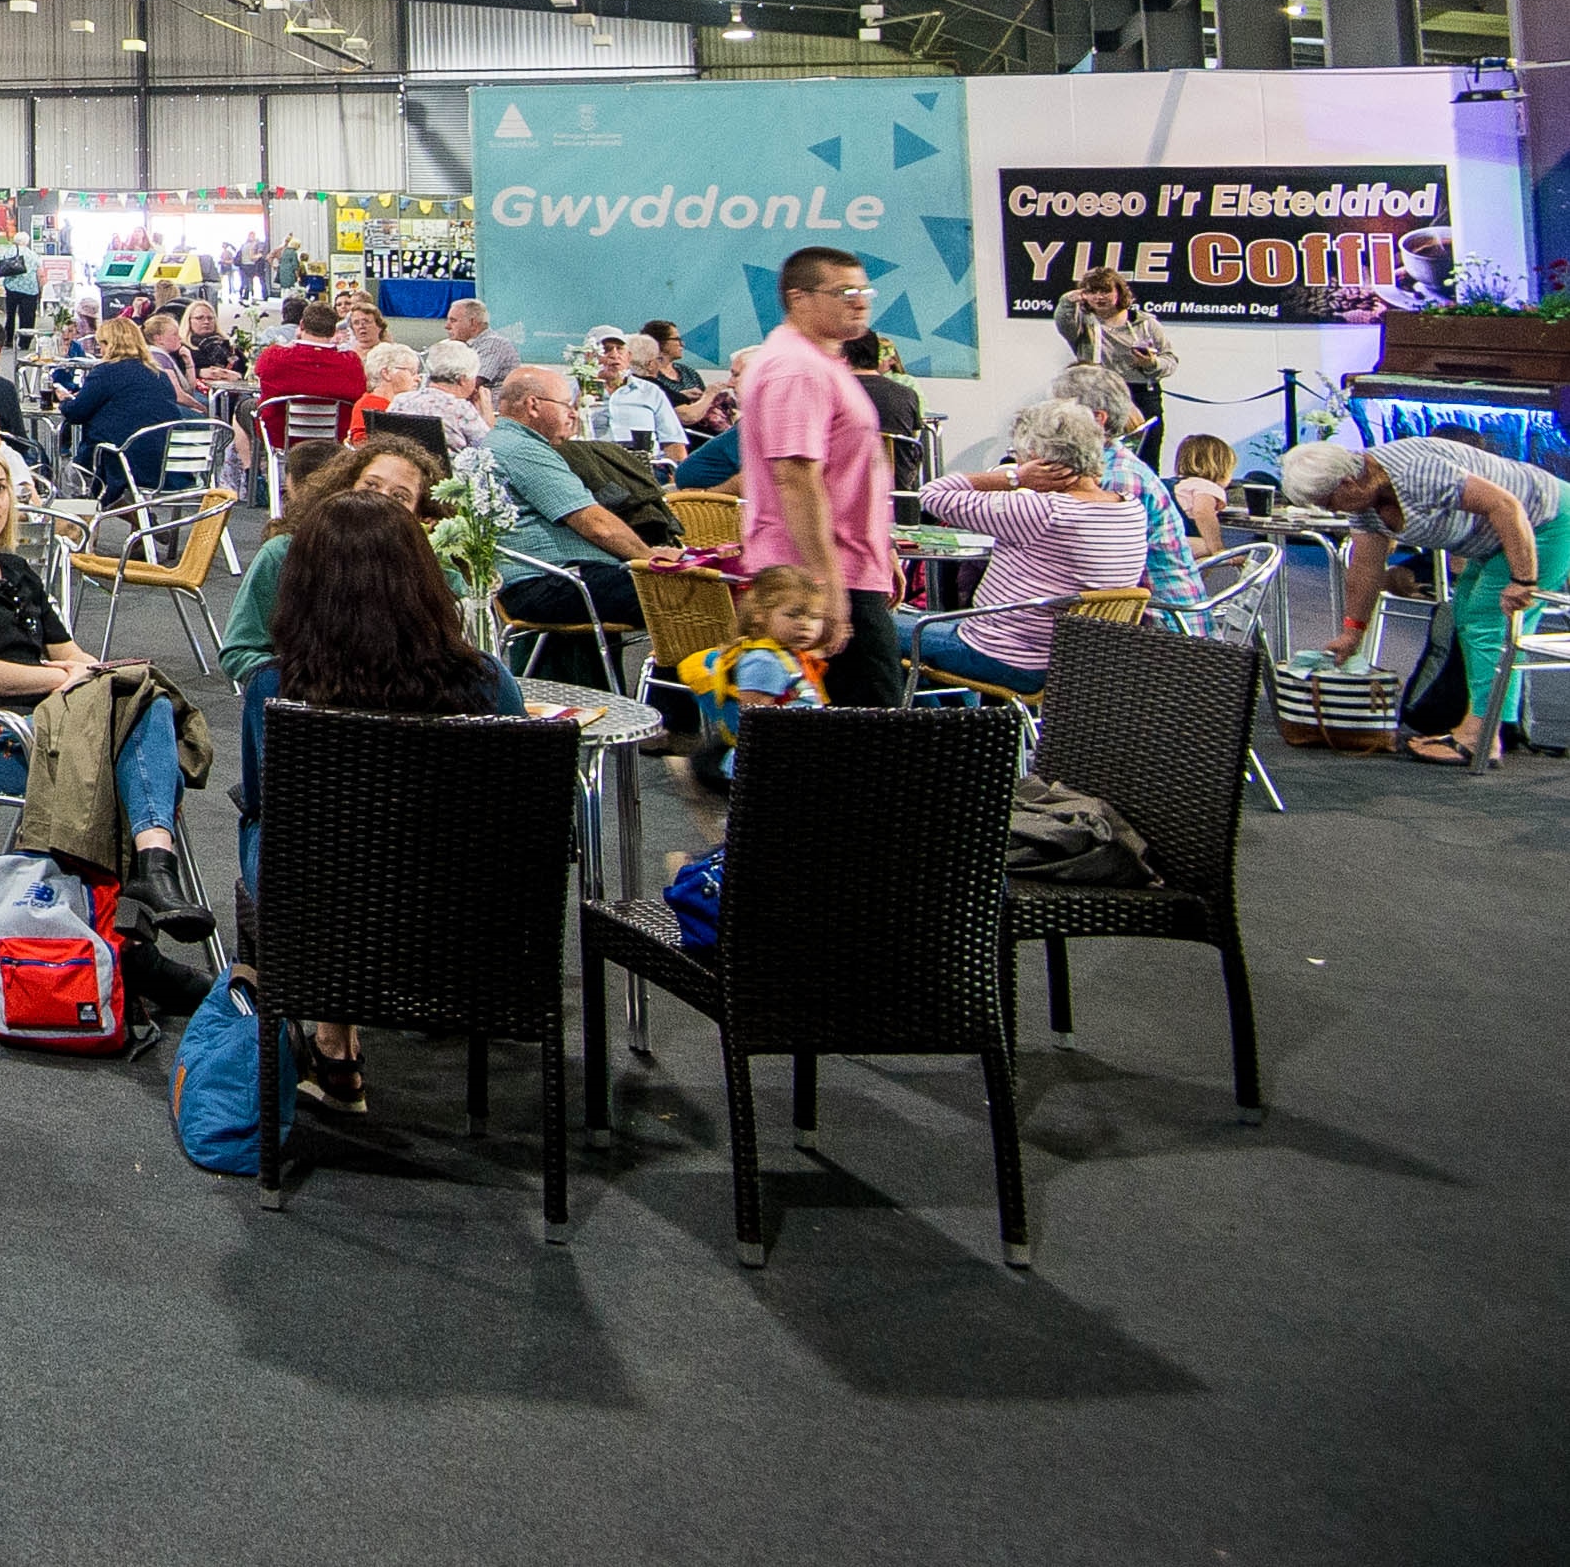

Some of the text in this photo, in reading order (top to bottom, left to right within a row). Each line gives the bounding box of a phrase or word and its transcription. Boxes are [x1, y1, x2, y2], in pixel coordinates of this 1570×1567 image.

[491, 184, 885, 237] GwyddonLe
[1008, 184, 1147, 217] Croeso
[1022, 241, 1065, 282] Y
[1188, 232, 1396, 287] Coffi
[1012, 298, 1054, 311] 100%
[1180, 301, 1246, 315] Masnach
[1249, 302, 1279, 317] Deg
